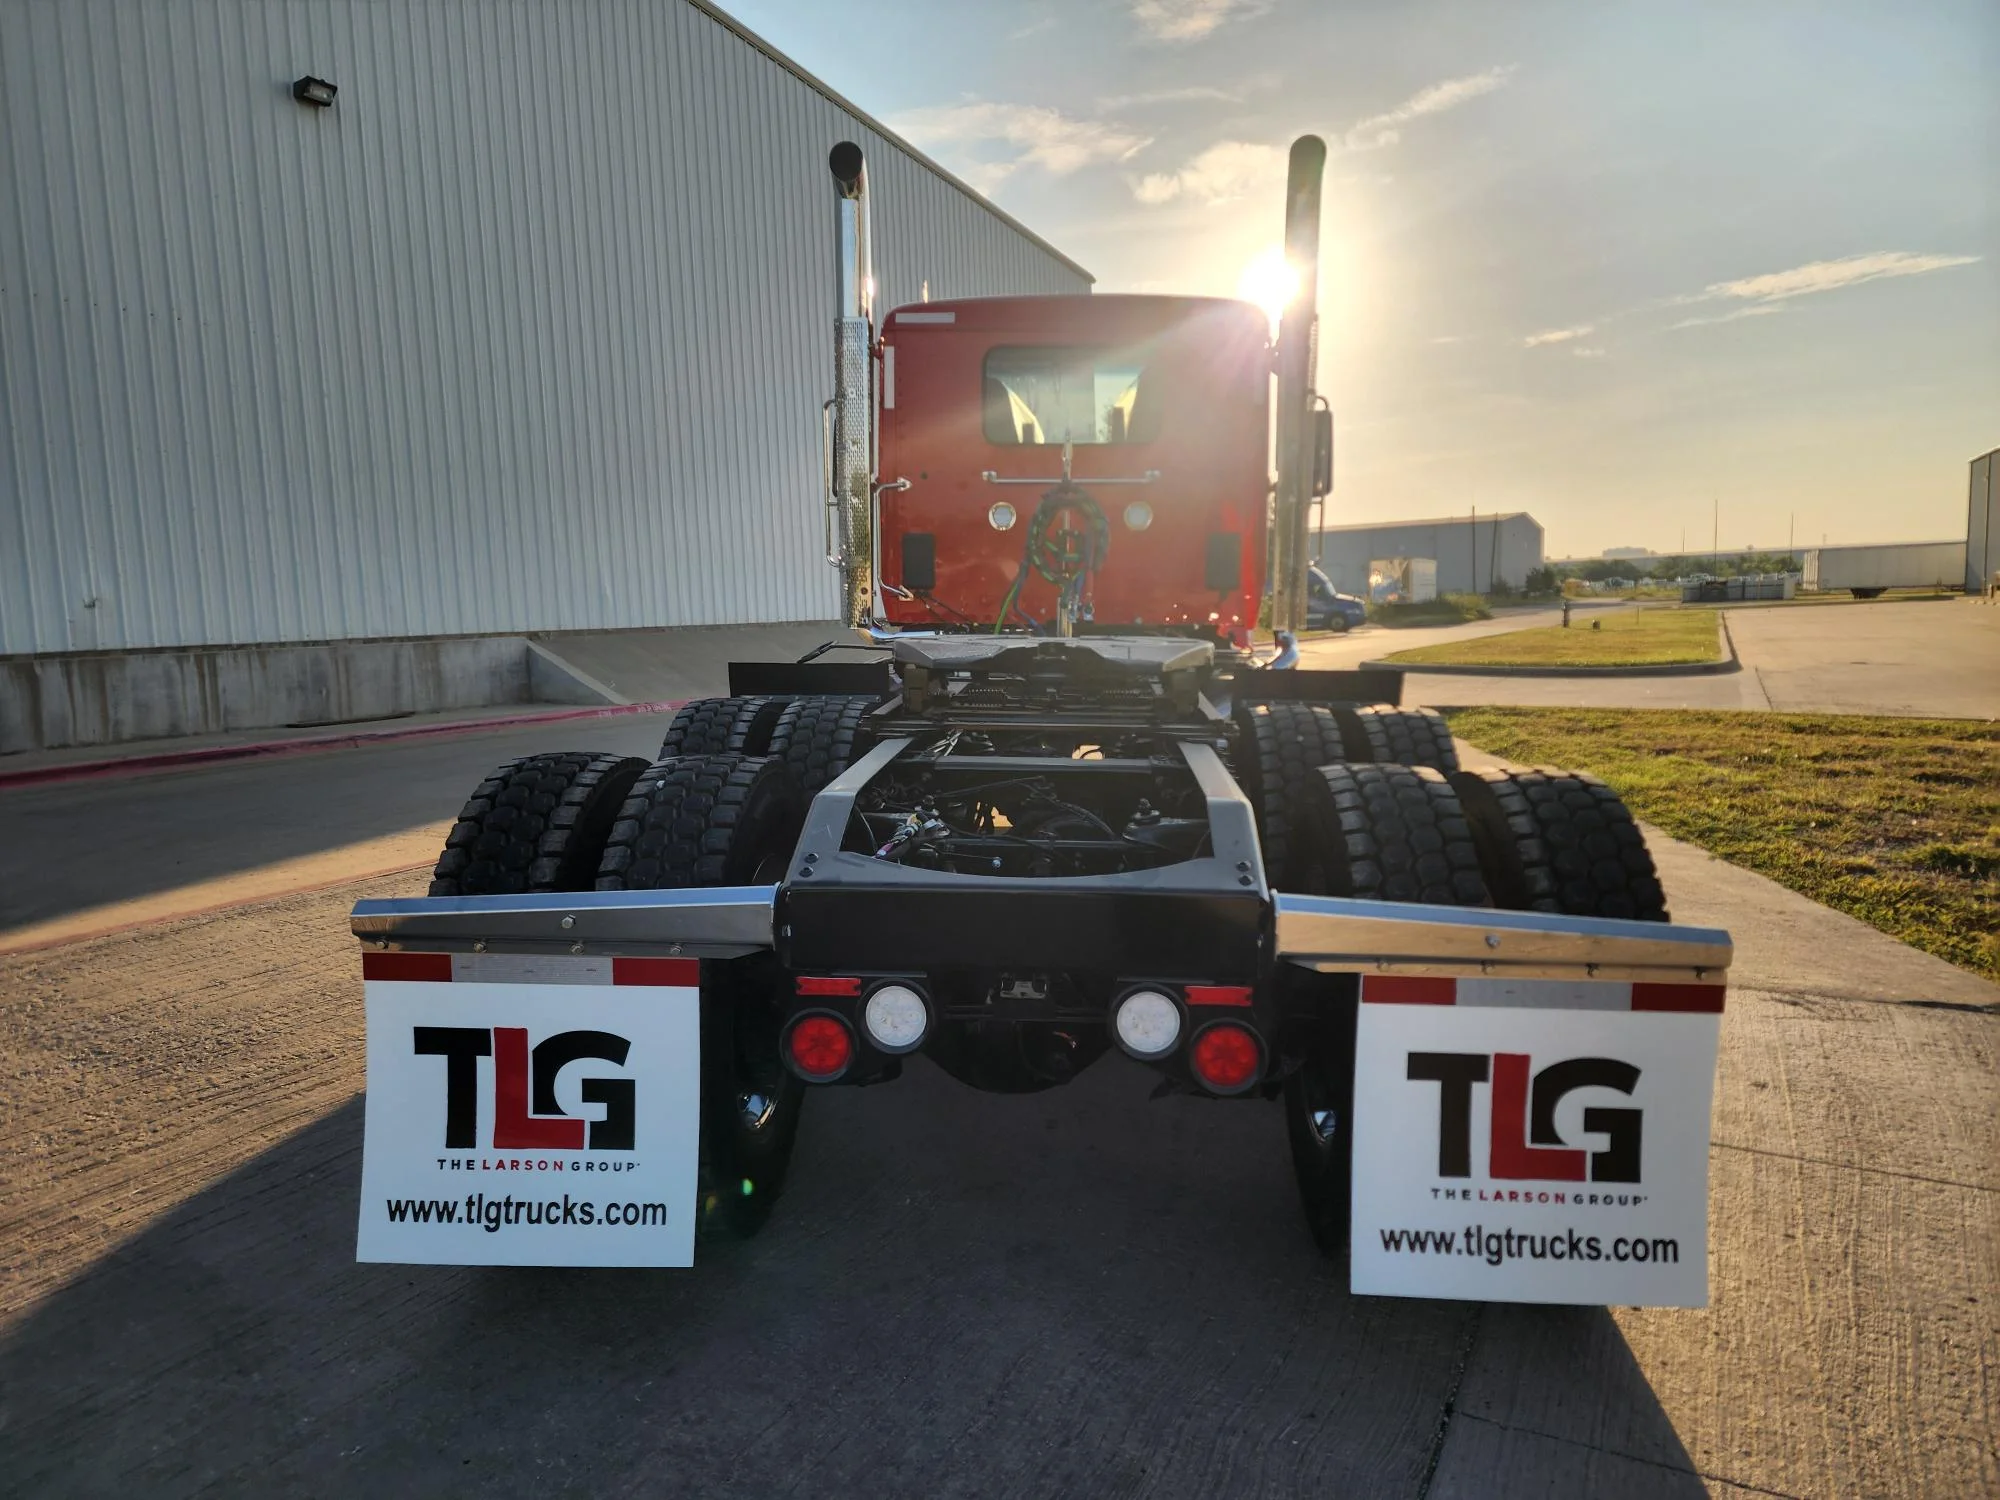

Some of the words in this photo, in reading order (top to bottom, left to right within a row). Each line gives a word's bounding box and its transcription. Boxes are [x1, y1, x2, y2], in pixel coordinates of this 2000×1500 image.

[413, 1026, 636, 1150] TLG
[1406, 1052, 1643, 1183] TLG
[437, 1159, 476, 1171] THE
[482, 1159, 564, 1172] LARSON
[571, 1161, 635, 1172] GROUP
[386, 1193, 667, 1233] www.tlgtrucks.com
[1431, 1187, 1472, 1201] THE
[1479, 1189, 1566, 1205] LARSON
[1573, 1193, 1643, 1207] GROUP
[1380, 1224, 1679, 1266] www.tlgtrucks.com
